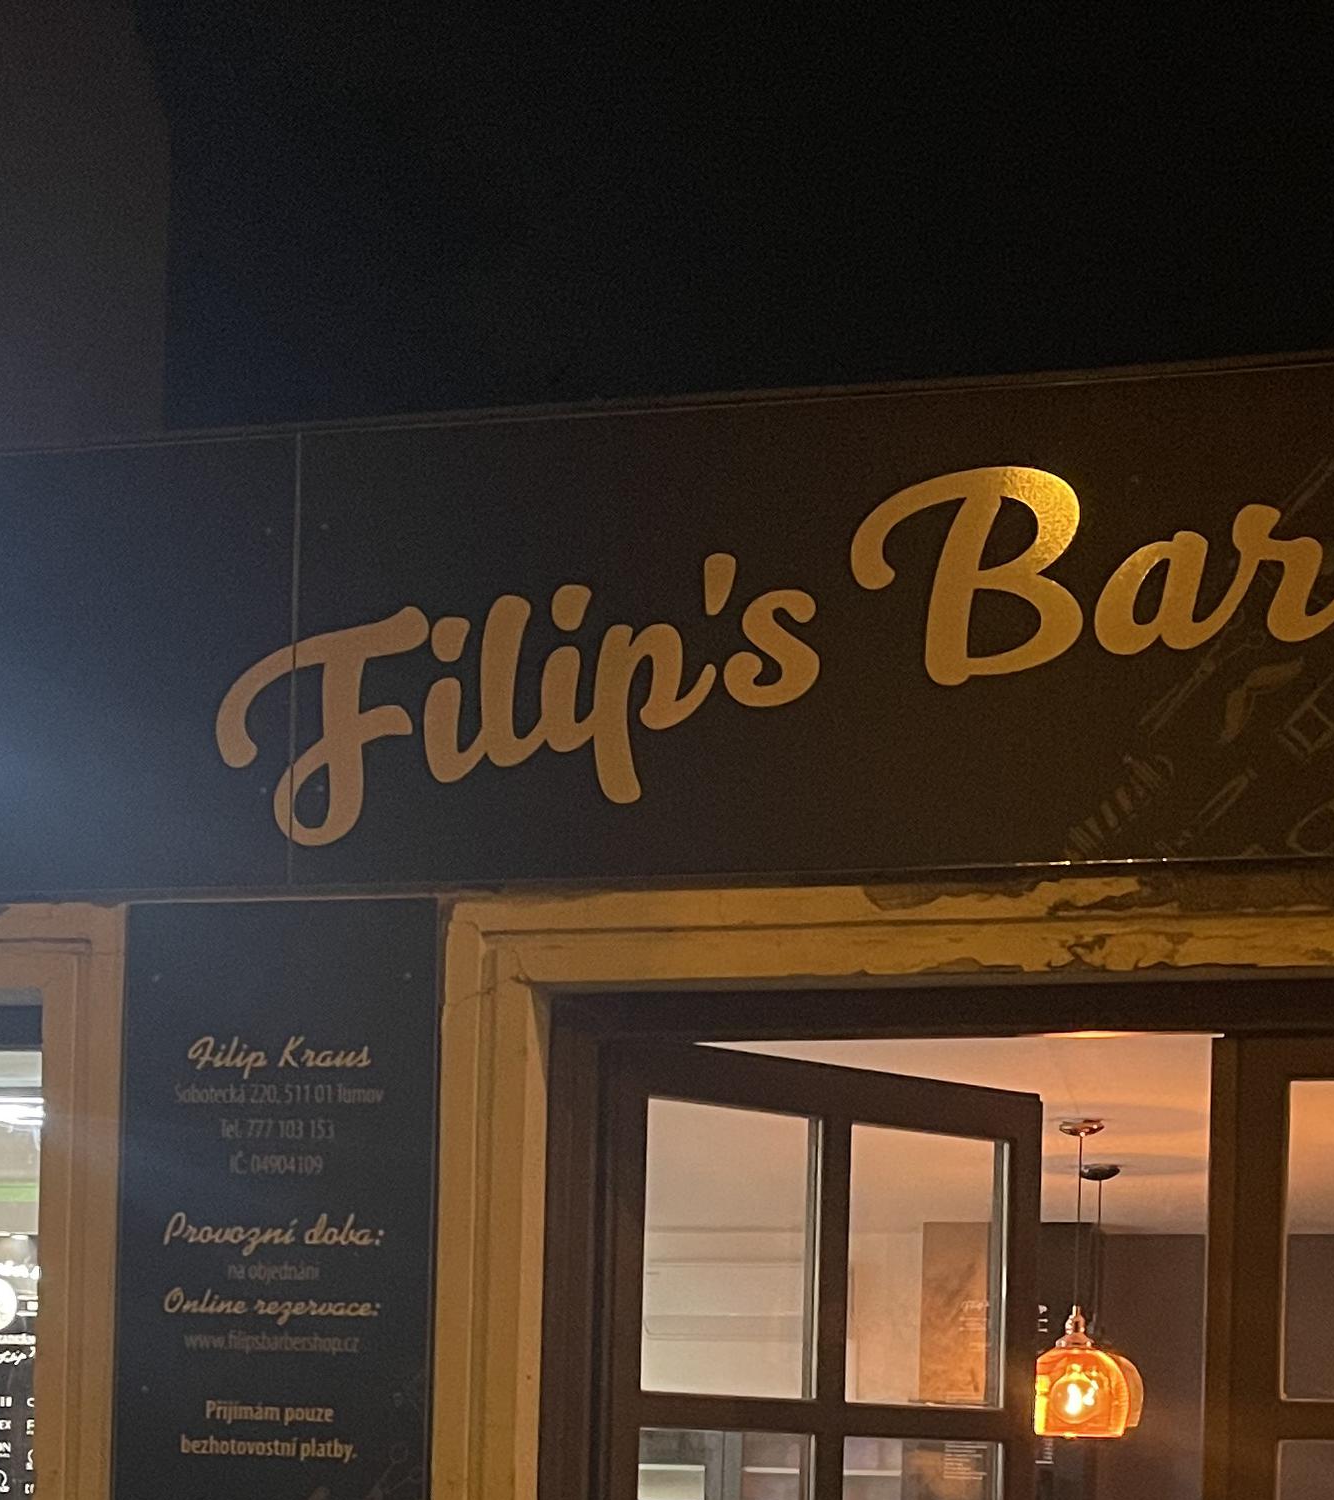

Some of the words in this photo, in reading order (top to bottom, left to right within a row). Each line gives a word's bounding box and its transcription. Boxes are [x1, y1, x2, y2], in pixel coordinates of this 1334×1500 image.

[216, 553, 821, 847] Filip's
[188, 1036, 267, 1079] Filip
[278, 1035, 372, 1069] Kraus
[164, 1212, 297, 1257] Provozní
[304, 1213, 385, 1246] doba:
[163, 1287, 249, 1314] Online
[254, 1300, 382, 1327] rezervace:
[205, 1399, 281, 1425] Přijímám
[284, 1405, 334, 1426] pouze
[180, 1433, 297, 1458] bezhotovostní
[300, 1436, 358, 1464] platby.
